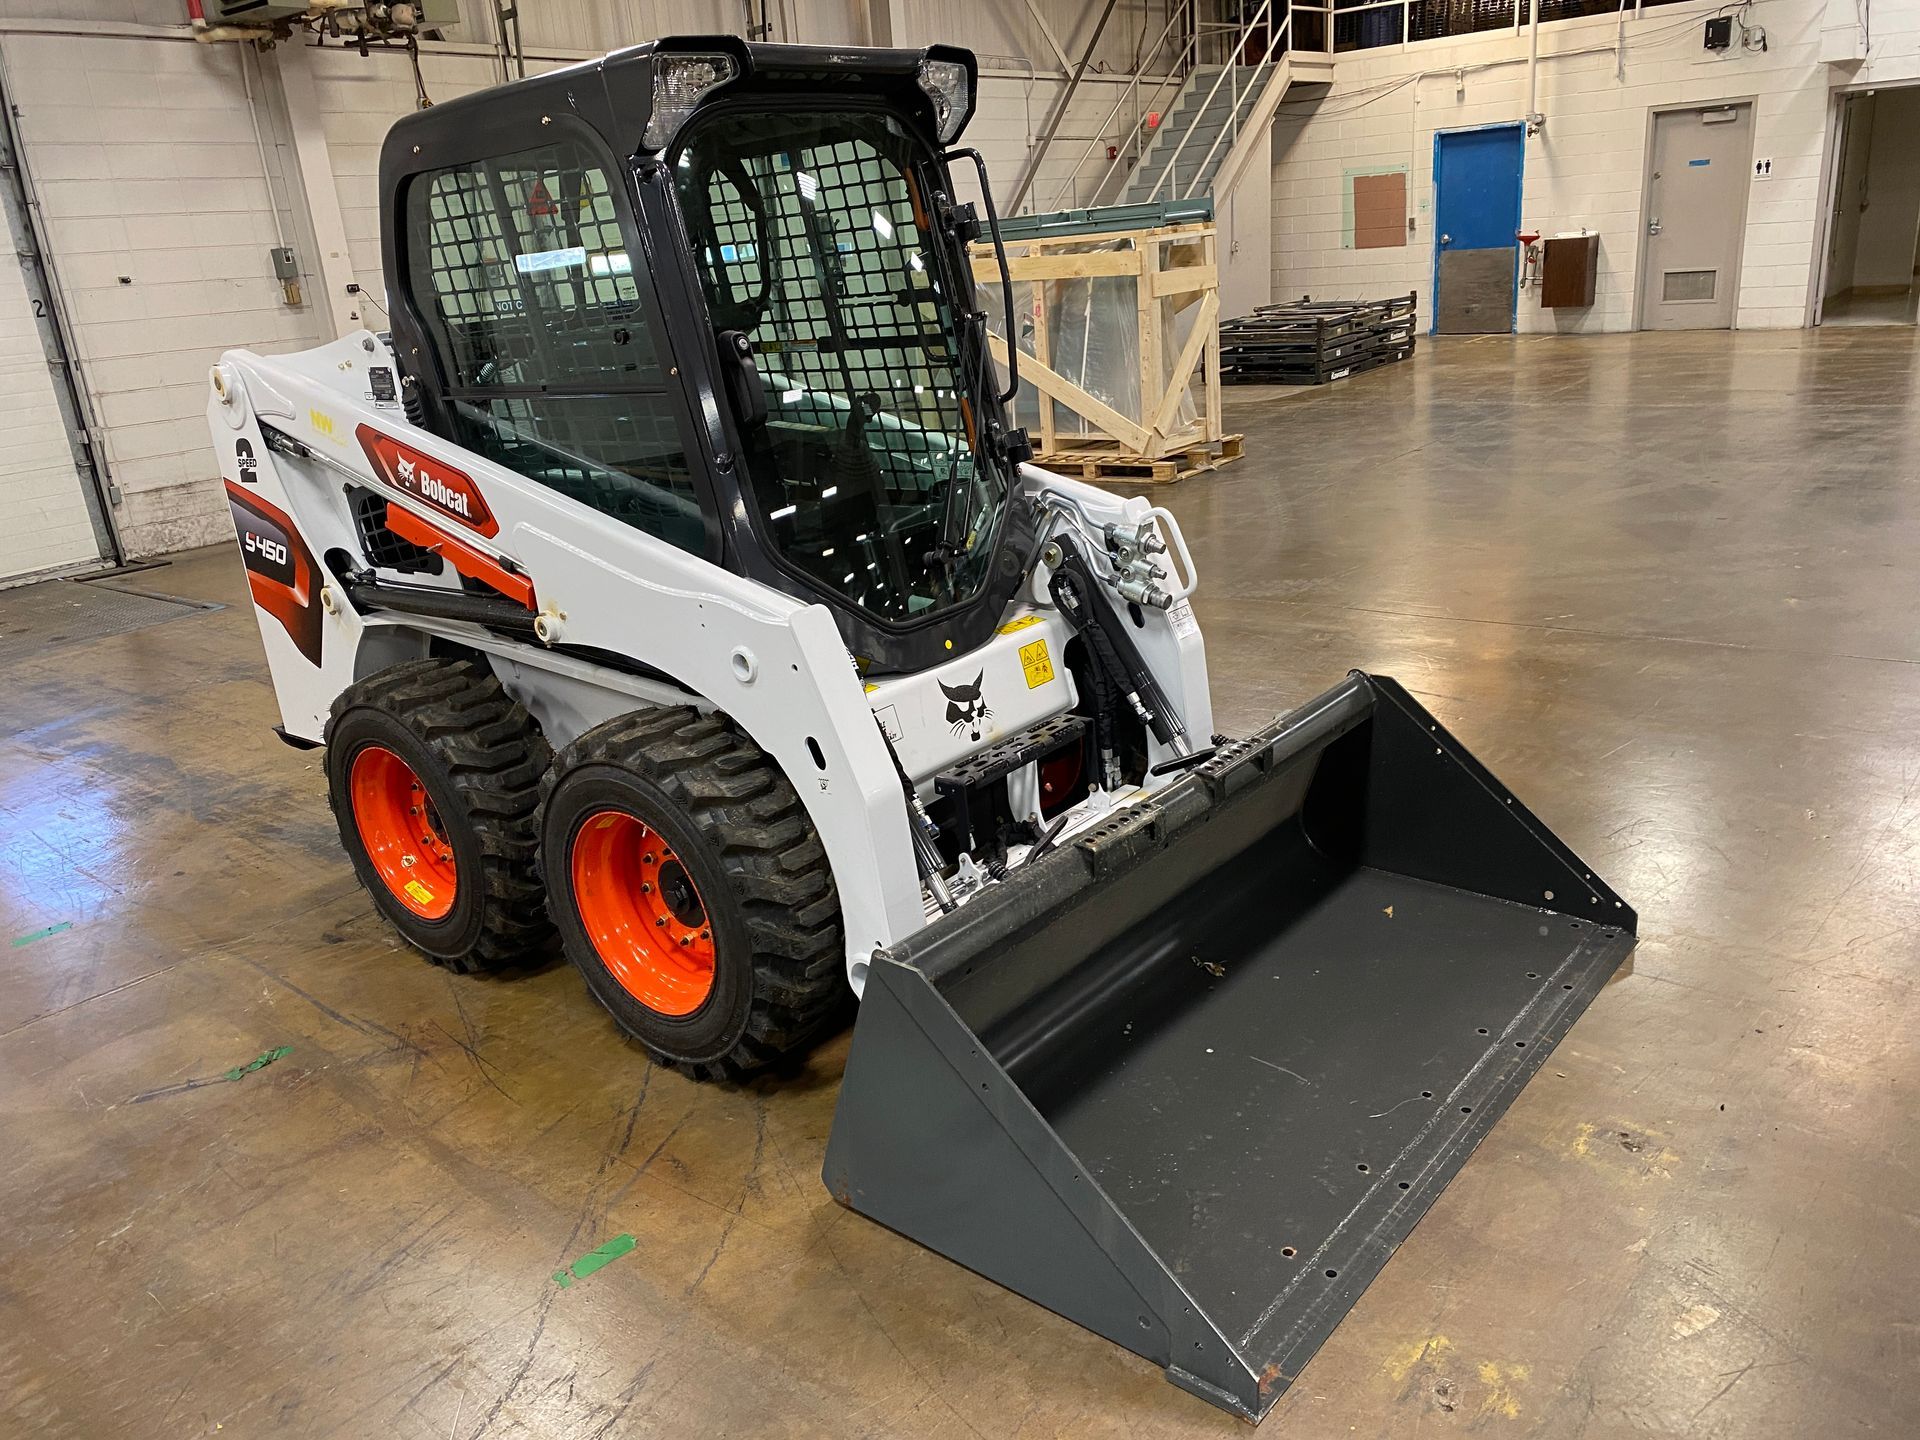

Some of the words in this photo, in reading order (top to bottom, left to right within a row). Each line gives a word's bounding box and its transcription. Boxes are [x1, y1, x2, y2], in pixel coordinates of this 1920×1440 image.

[32, 299, 46, 318] 2
[237, 458, 257, 468] SPEED
[420, 469, 469, 518] Bobcat
[245, 531, 287, 566] S450
